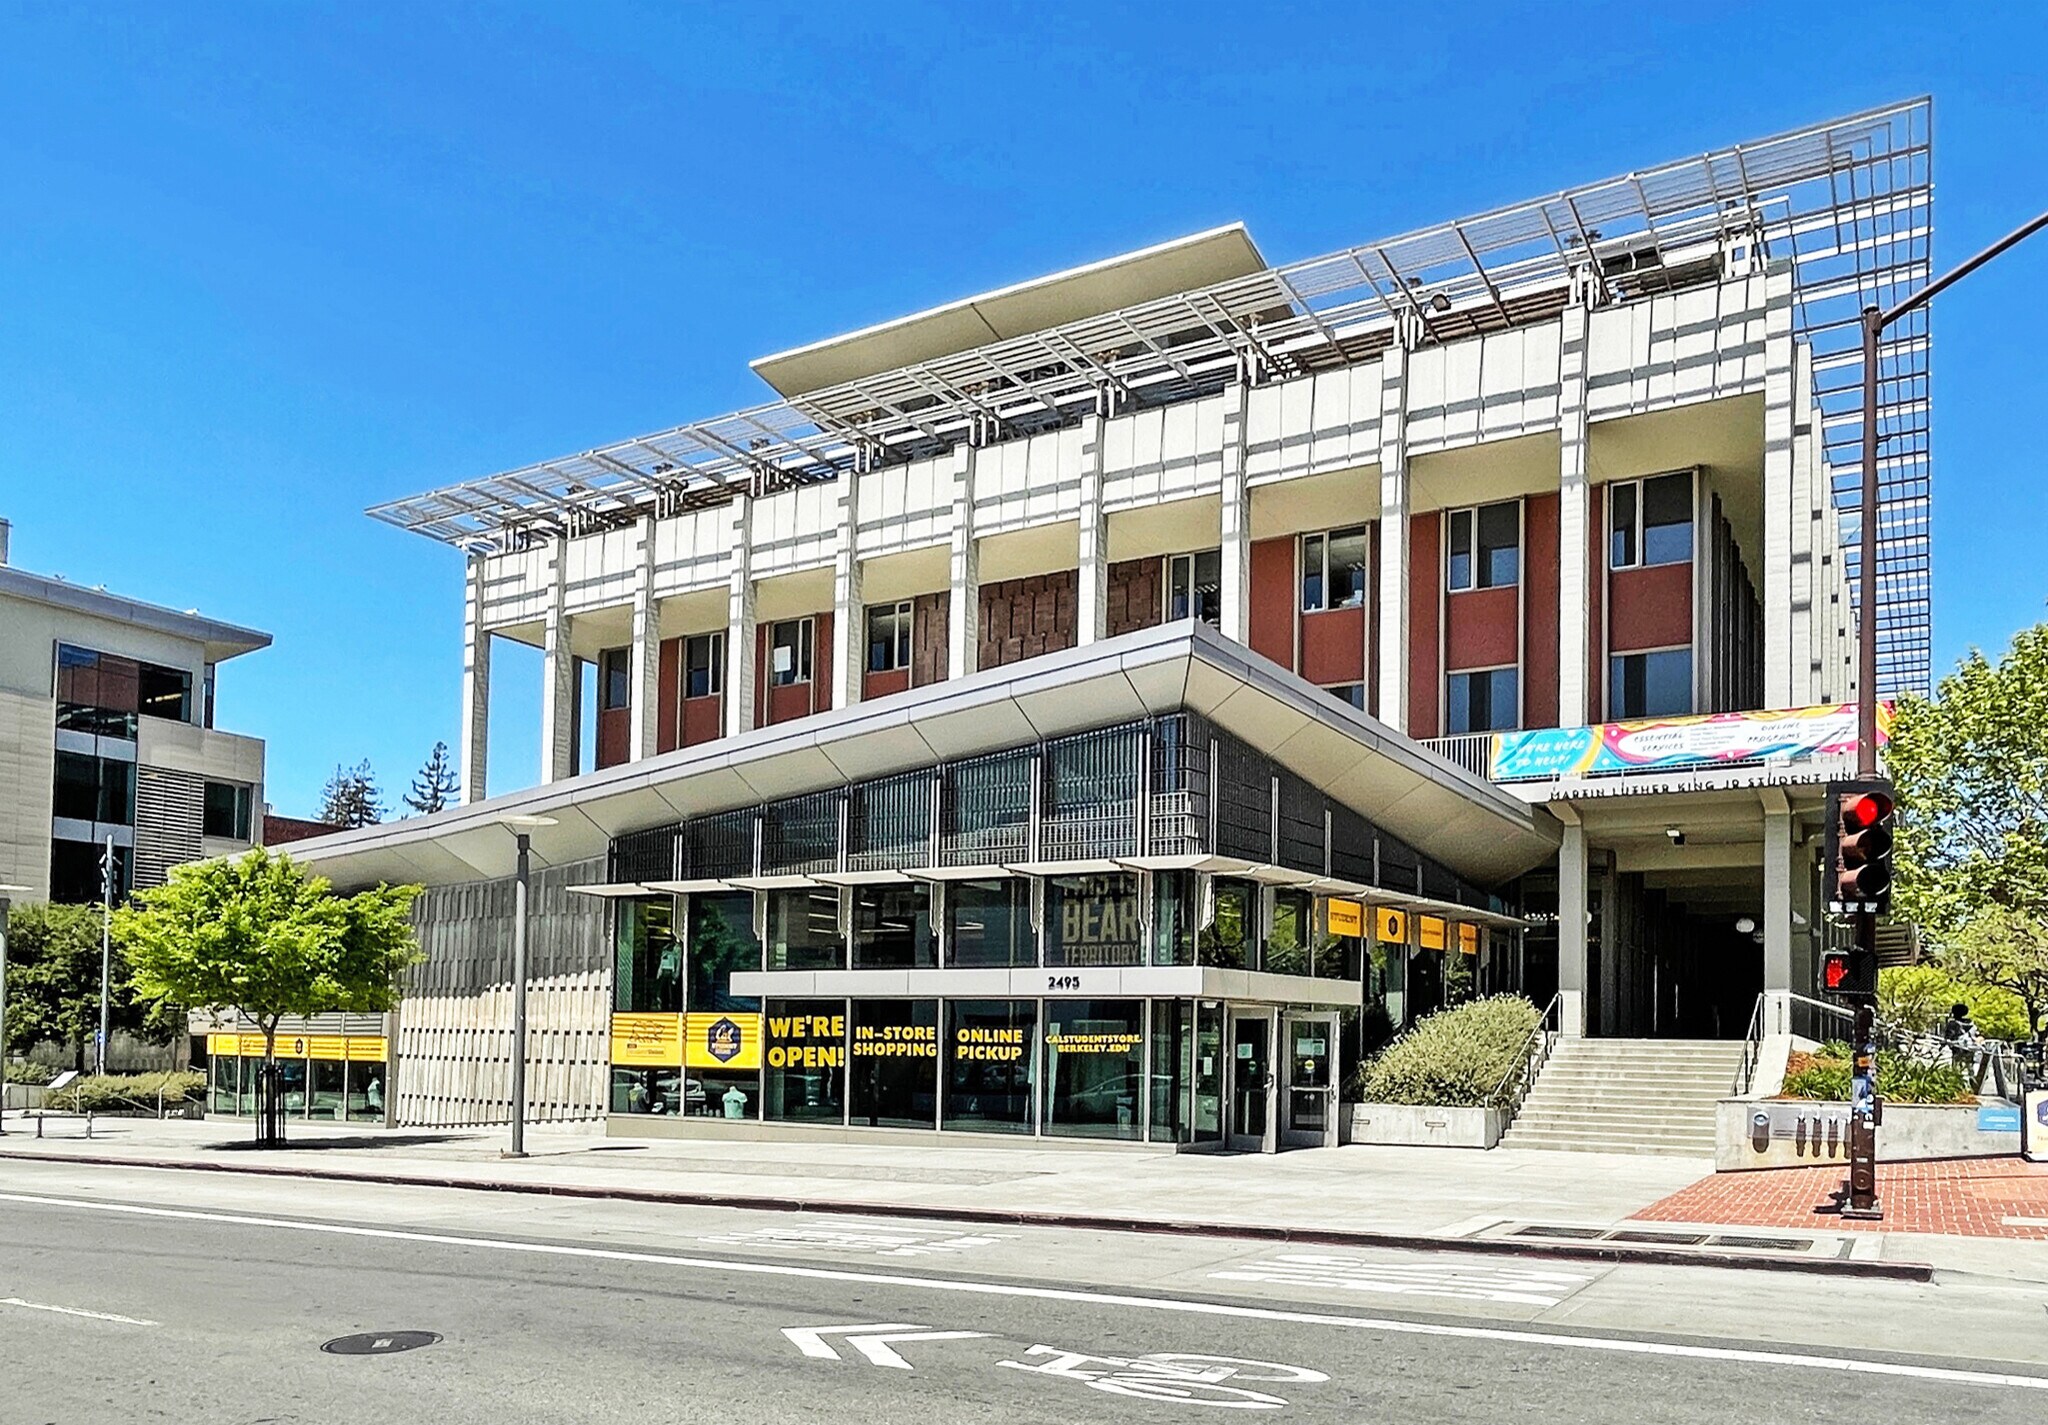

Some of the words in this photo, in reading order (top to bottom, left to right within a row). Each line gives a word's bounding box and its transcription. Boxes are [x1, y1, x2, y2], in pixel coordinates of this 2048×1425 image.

[1761, 722, 1801, 731] ONLINE
[1634, 732, 1684, 743] ESSENTIAL
[1747, 732, 1801, 743] PROGRAMS
[1553, 740, 1585, 752] HERE
[1641, 742, 1684, 752] SERVICES
[1515, 757, 1532, 767] TO
[1551, 787, 1604, 801] MARTIN
[1613, 784, 1669, 797] LUTHER
[1678, 780, 1715, 792] KING
[1723, 778, 1739, 790] JR
[1748, 773, 1821, 788] STUDENT
[1062, 896, 1138, 943] BEAR
[1062, 944, 1138, 966] TERRITORY
[1048, 976, 1080, 988] 2495
[715, 1024, 734, 1042] Cal
[768, 1015, 844, 1038] WE'RE
[855, 1025, 936, 1041] IN-STORE
[957, 1028, 1023, 1043] ONLINE
[1044, 1034, 1143, 1044] CALSTUDENTSTORE.
[853, 1042, 938, 1058] SHOPPING
[957, 1045, 1022, 1060] PICKUP
[1057, 1044, 1131, 1053] BERKELEY.EDU
[768, 1046, 844, 1068] OPEN!
